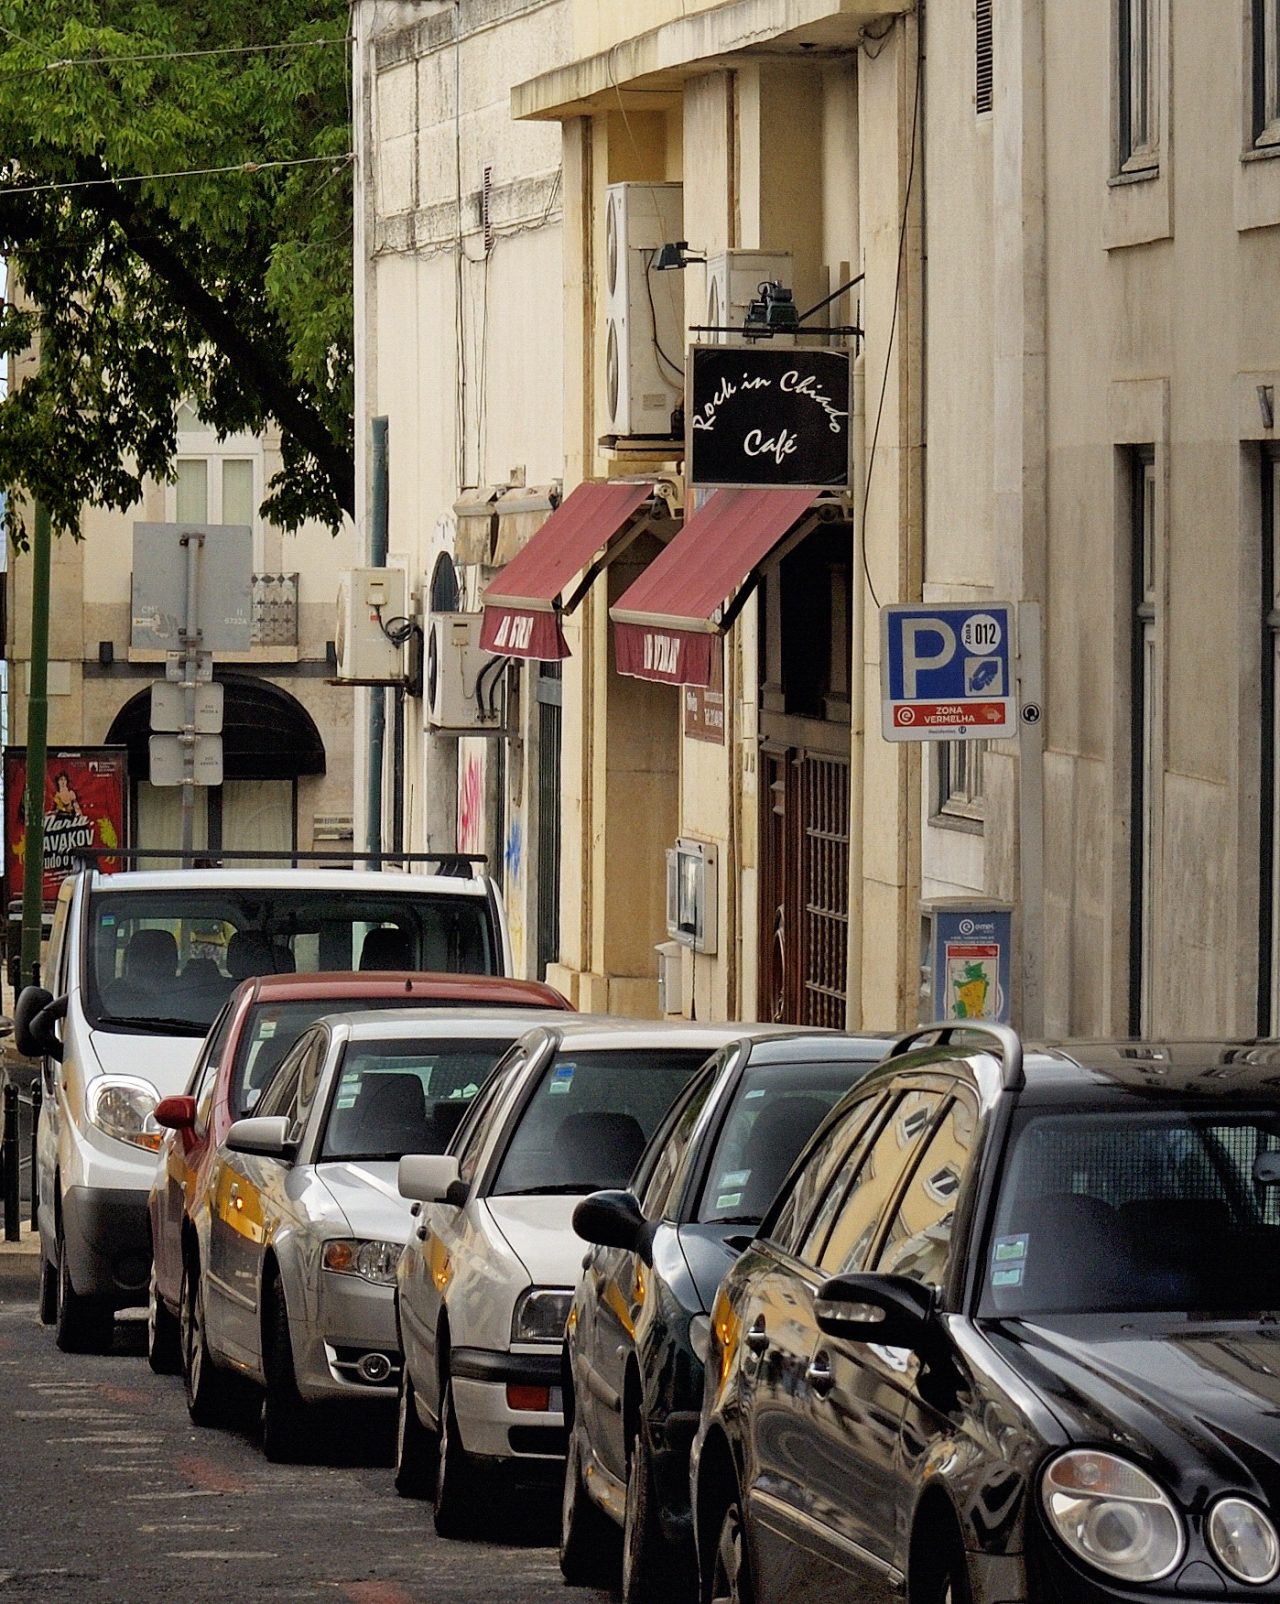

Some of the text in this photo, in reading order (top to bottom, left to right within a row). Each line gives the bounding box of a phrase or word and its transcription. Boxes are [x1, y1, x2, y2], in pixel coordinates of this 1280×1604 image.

[692, 370, 849, 434] Rock in Chiado
[743, 428, 798, 465] Café
[975, 623, 997, 645] 012
[901, 617, 957, 699] P
[923, 714, 976, 724] VERMELHA
[935, 706, 964, 715] ZONA
[42, 829, 95, 852] AVAKOV
[44, 853, 62, 869] udo
